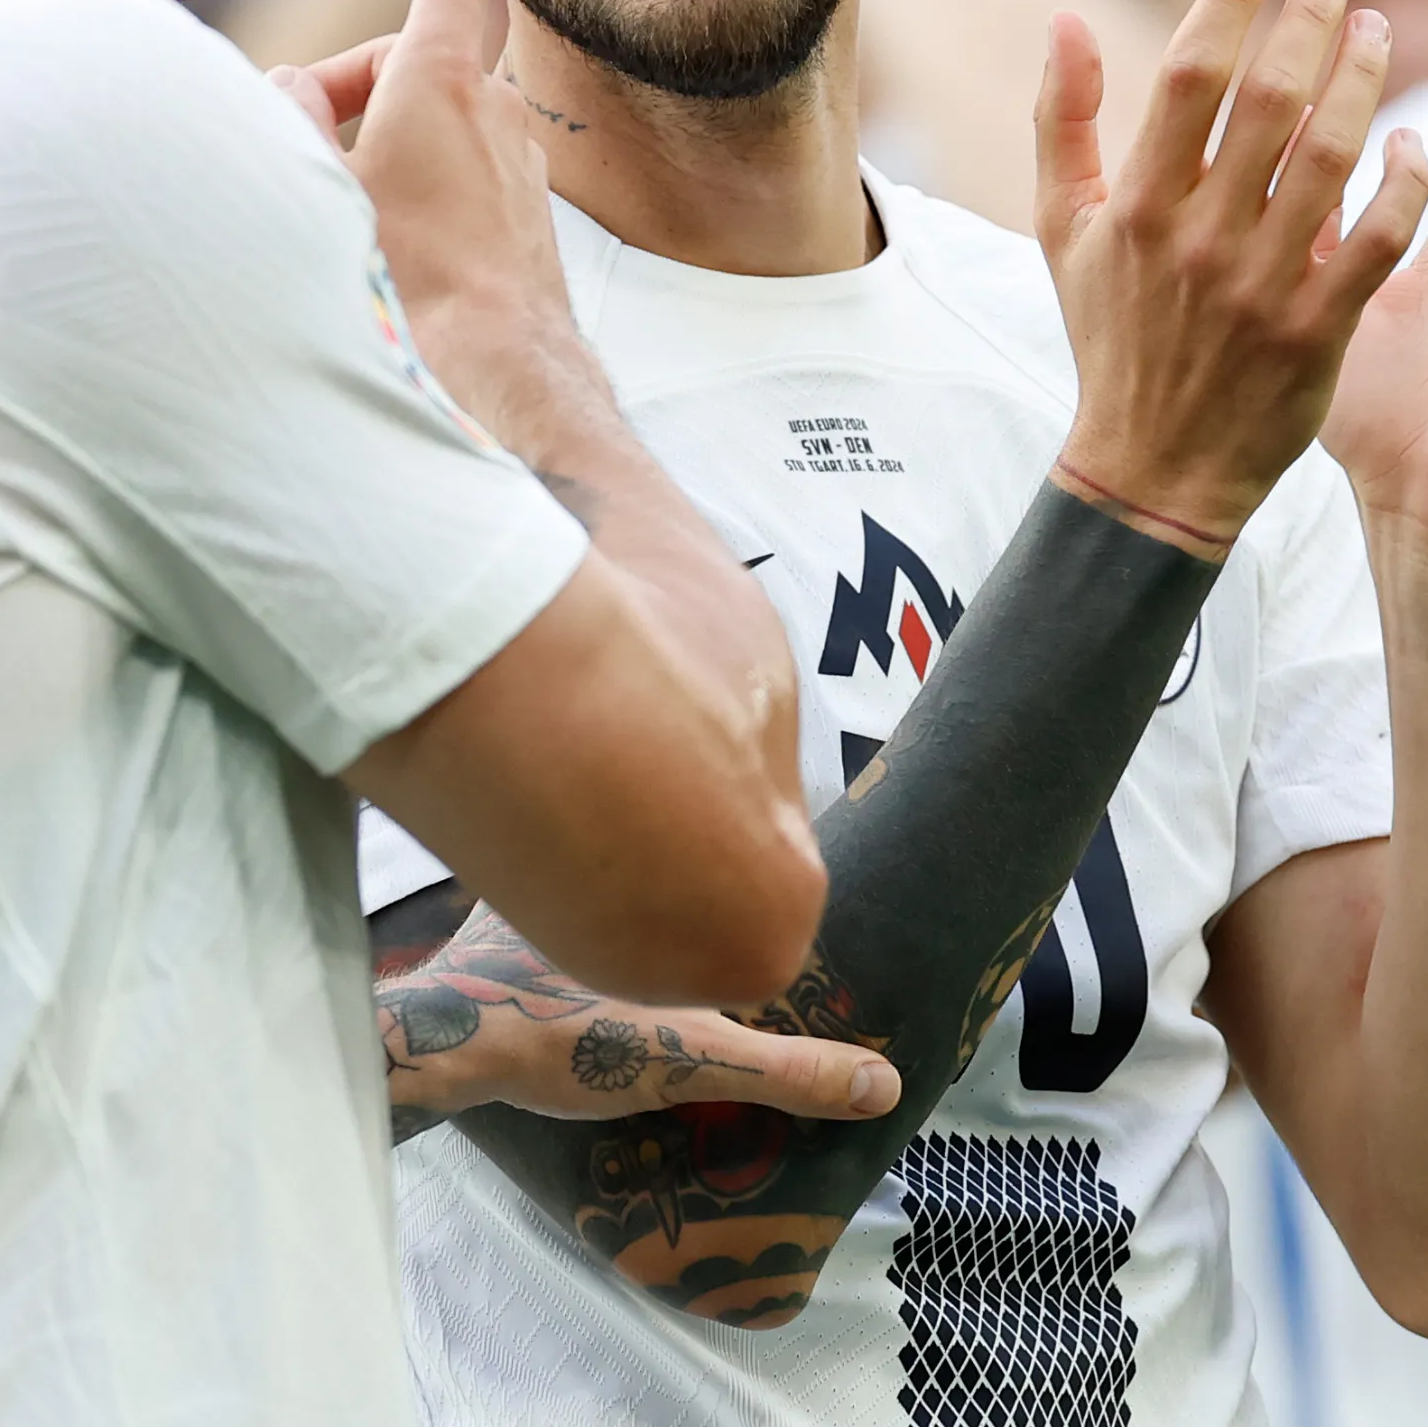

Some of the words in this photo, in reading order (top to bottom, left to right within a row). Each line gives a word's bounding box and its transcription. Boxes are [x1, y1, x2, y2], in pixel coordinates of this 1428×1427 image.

[788, 419, 816, 433] UEFA
[815, 417, 844, 432] EURO
[843, 417, 869, 432] 2024
[801, 438, 834, 455] SVN
[844, 437, 873, 454] DEN
[877, 459, 906, 473] 2024
